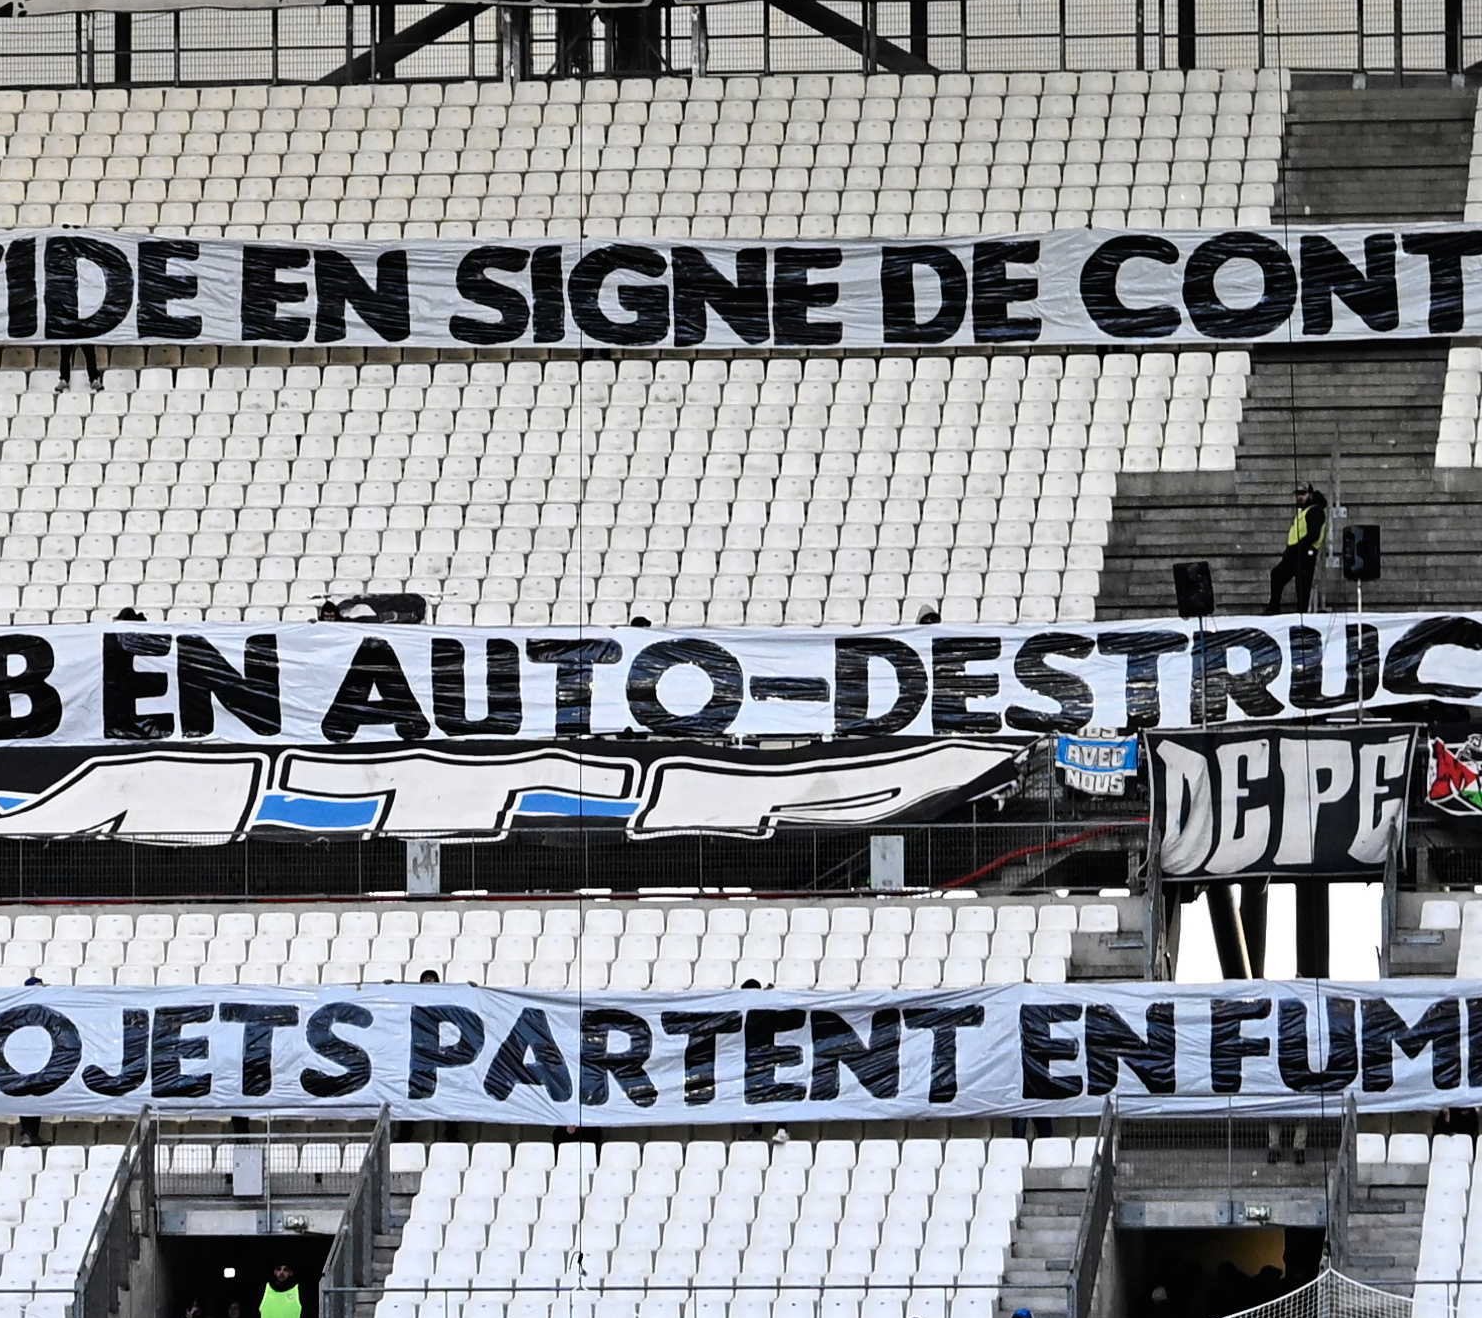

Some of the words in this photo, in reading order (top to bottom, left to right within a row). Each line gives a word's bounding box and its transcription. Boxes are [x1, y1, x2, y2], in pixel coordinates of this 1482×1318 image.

[239, 241, 412, 344] EN
[447, 243, 842, 348] SIGNE
[879, 240, 1042, 345] DE
[102, 632, 280, 742] EN
[1065, 744, 1127, 768] AVEC
[1065, 768, 1125, 796] NOUS
[409, 1002, 986, 1109] PARTENT
[1020, 1002, 1178, 1101] EN
